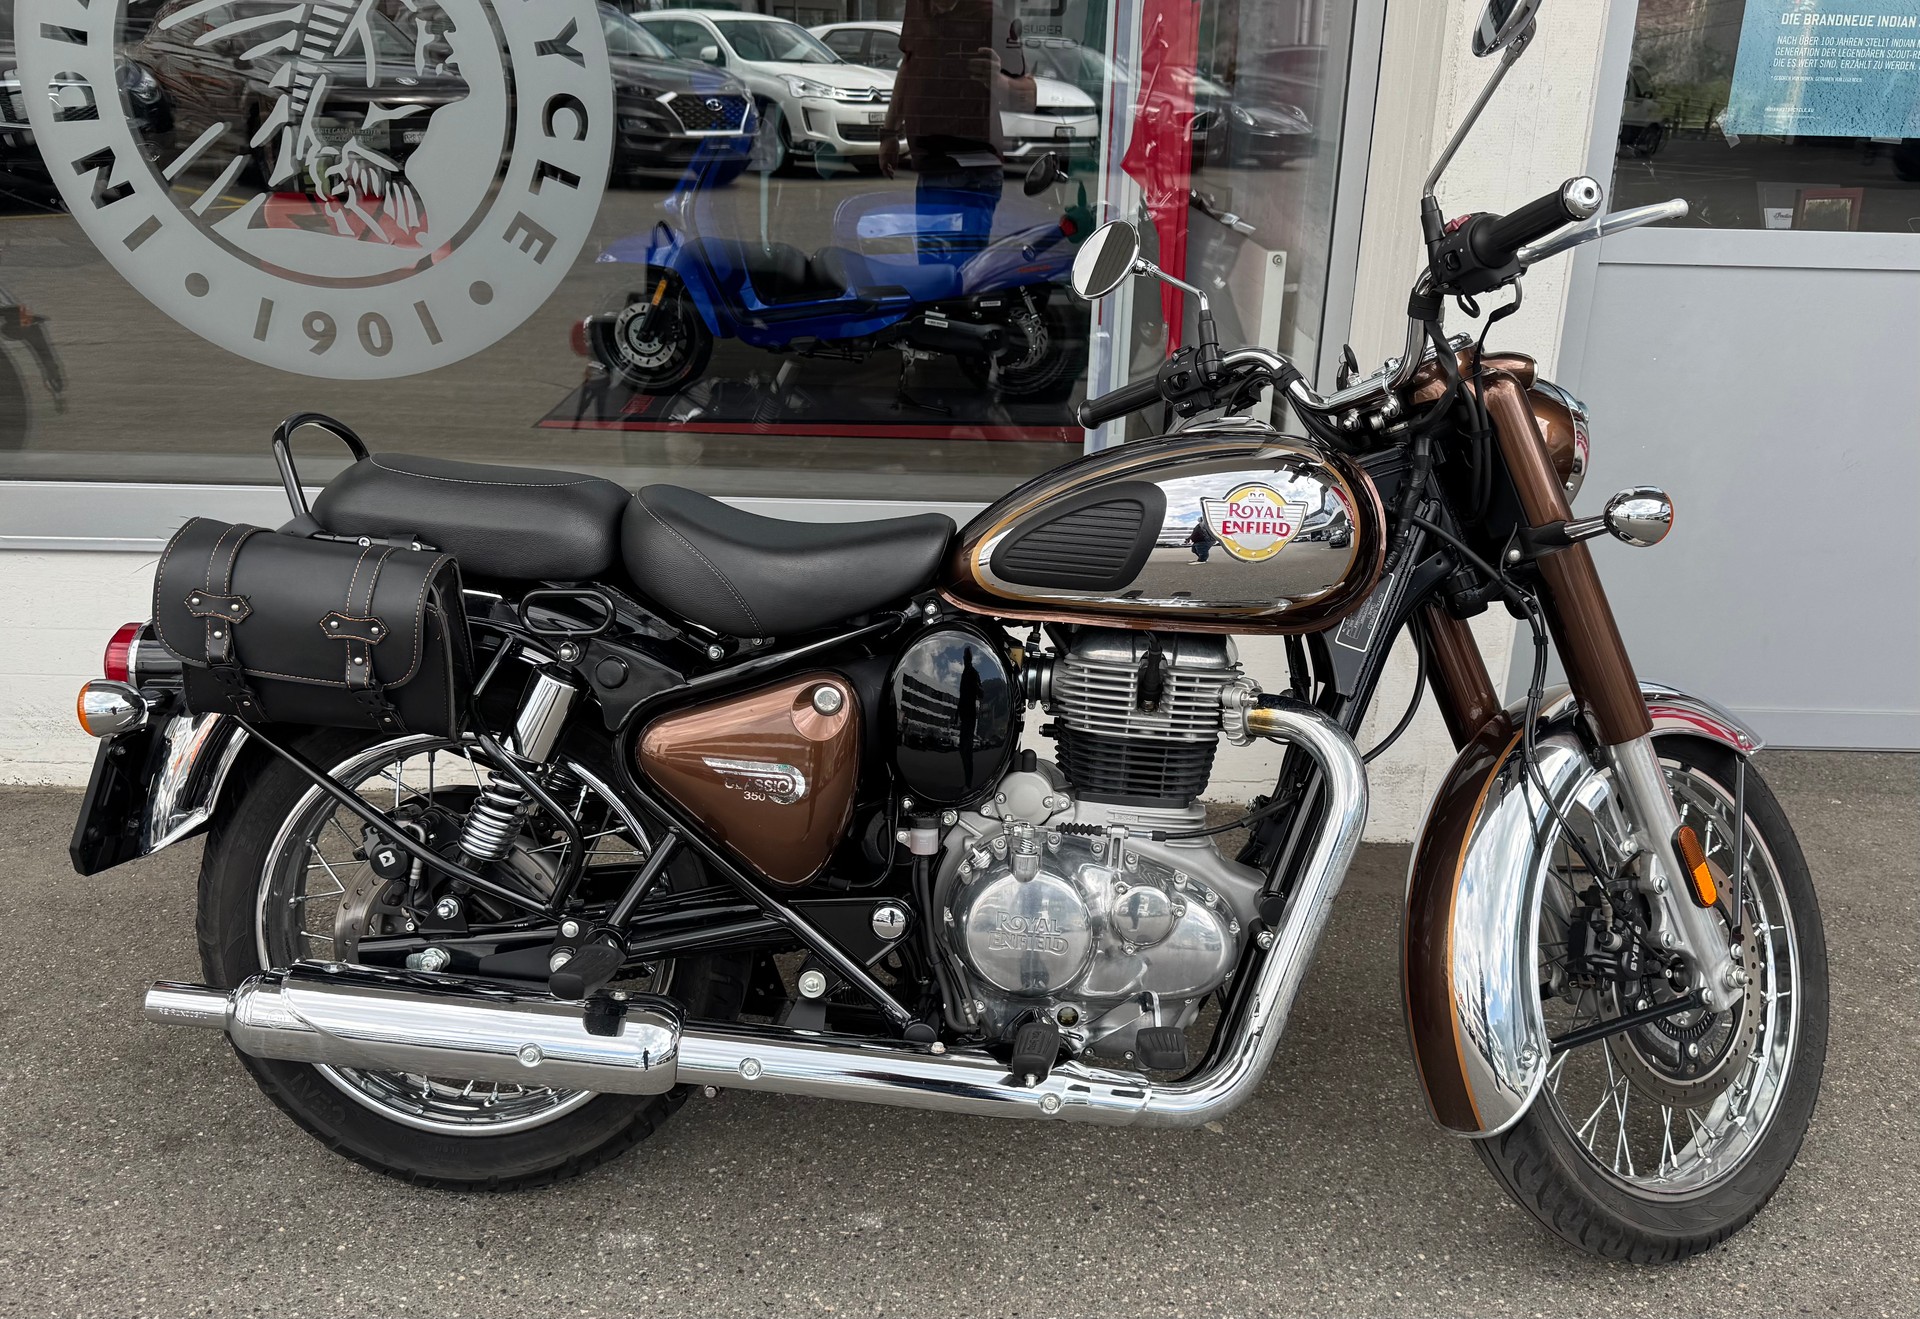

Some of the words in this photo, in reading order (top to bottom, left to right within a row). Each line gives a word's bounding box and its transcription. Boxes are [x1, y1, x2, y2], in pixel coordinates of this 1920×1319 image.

[1781, 13, 1802, 25] DIE
[1803, 13, 1876, 27] BRANDNEUE
[1877, 15, 1917, 28] INDIAN
[1023, 24, 1063, 35] SUPER
[1777, 35, 1797, 45] NACH
[1799, 34, 1819, 45] ÜBER
[1820, 36, 1835, 46] 100
[1835, 36, 1864, 47] JAHREN
[1865, 38, 1890, 47] STELLT
[1891, 38, 1916, 48] INDIAN
[1775, 47, 1820, 57] GENERATION
[1821, 47, 1837, 57] DER
[1838, 47, 1886, 58] LEGENDÄREN
[1773, 58, 1785, 67] DIE
[1787, 58, 1796, 68] ES
[1797, 58, 1819, 68] WERT
[1840, 59, 1872, 70] ERZÄHLT
[1873, 60, 1883, 70] ZU
[40, 0, 163, 253] INDI
[502, 0, 589, 265] YCLE
[253, 297, 442, 357] 1901
[1229, 502, 1284, 519] ROYAL
[1222, 520, 1291, 537] ENFIELD
[743, 790, 766, 802] 350
[995, 910, 1061, 936] ROYAL
[988, 930, 1069, 956] ENFIELD
